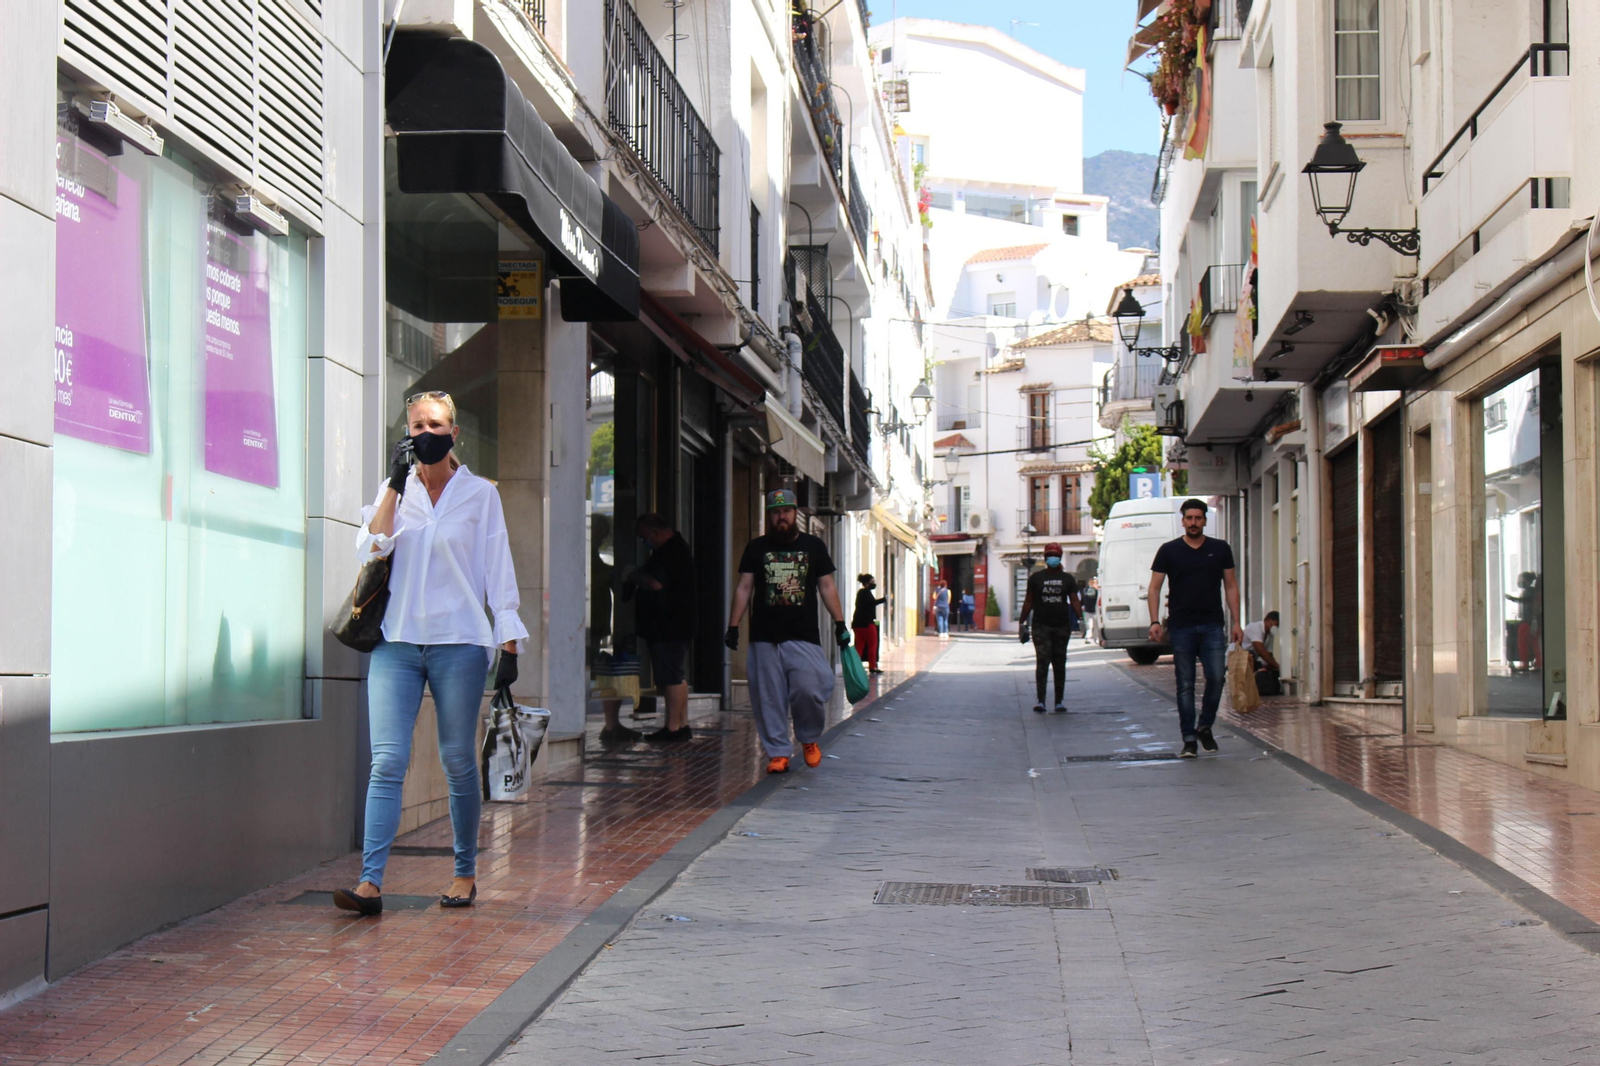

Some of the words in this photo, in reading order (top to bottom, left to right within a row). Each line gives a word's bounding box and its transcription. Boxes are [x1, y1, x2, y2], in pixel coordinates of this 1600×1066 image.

[56, 192, 81, 223] añana.
[211, 288, 231, 312] porque
[55, 324, 73, 348] ncia
[108, 408, 137, 422] DENTIX
[243, 438, 264, 449] DENTIX
